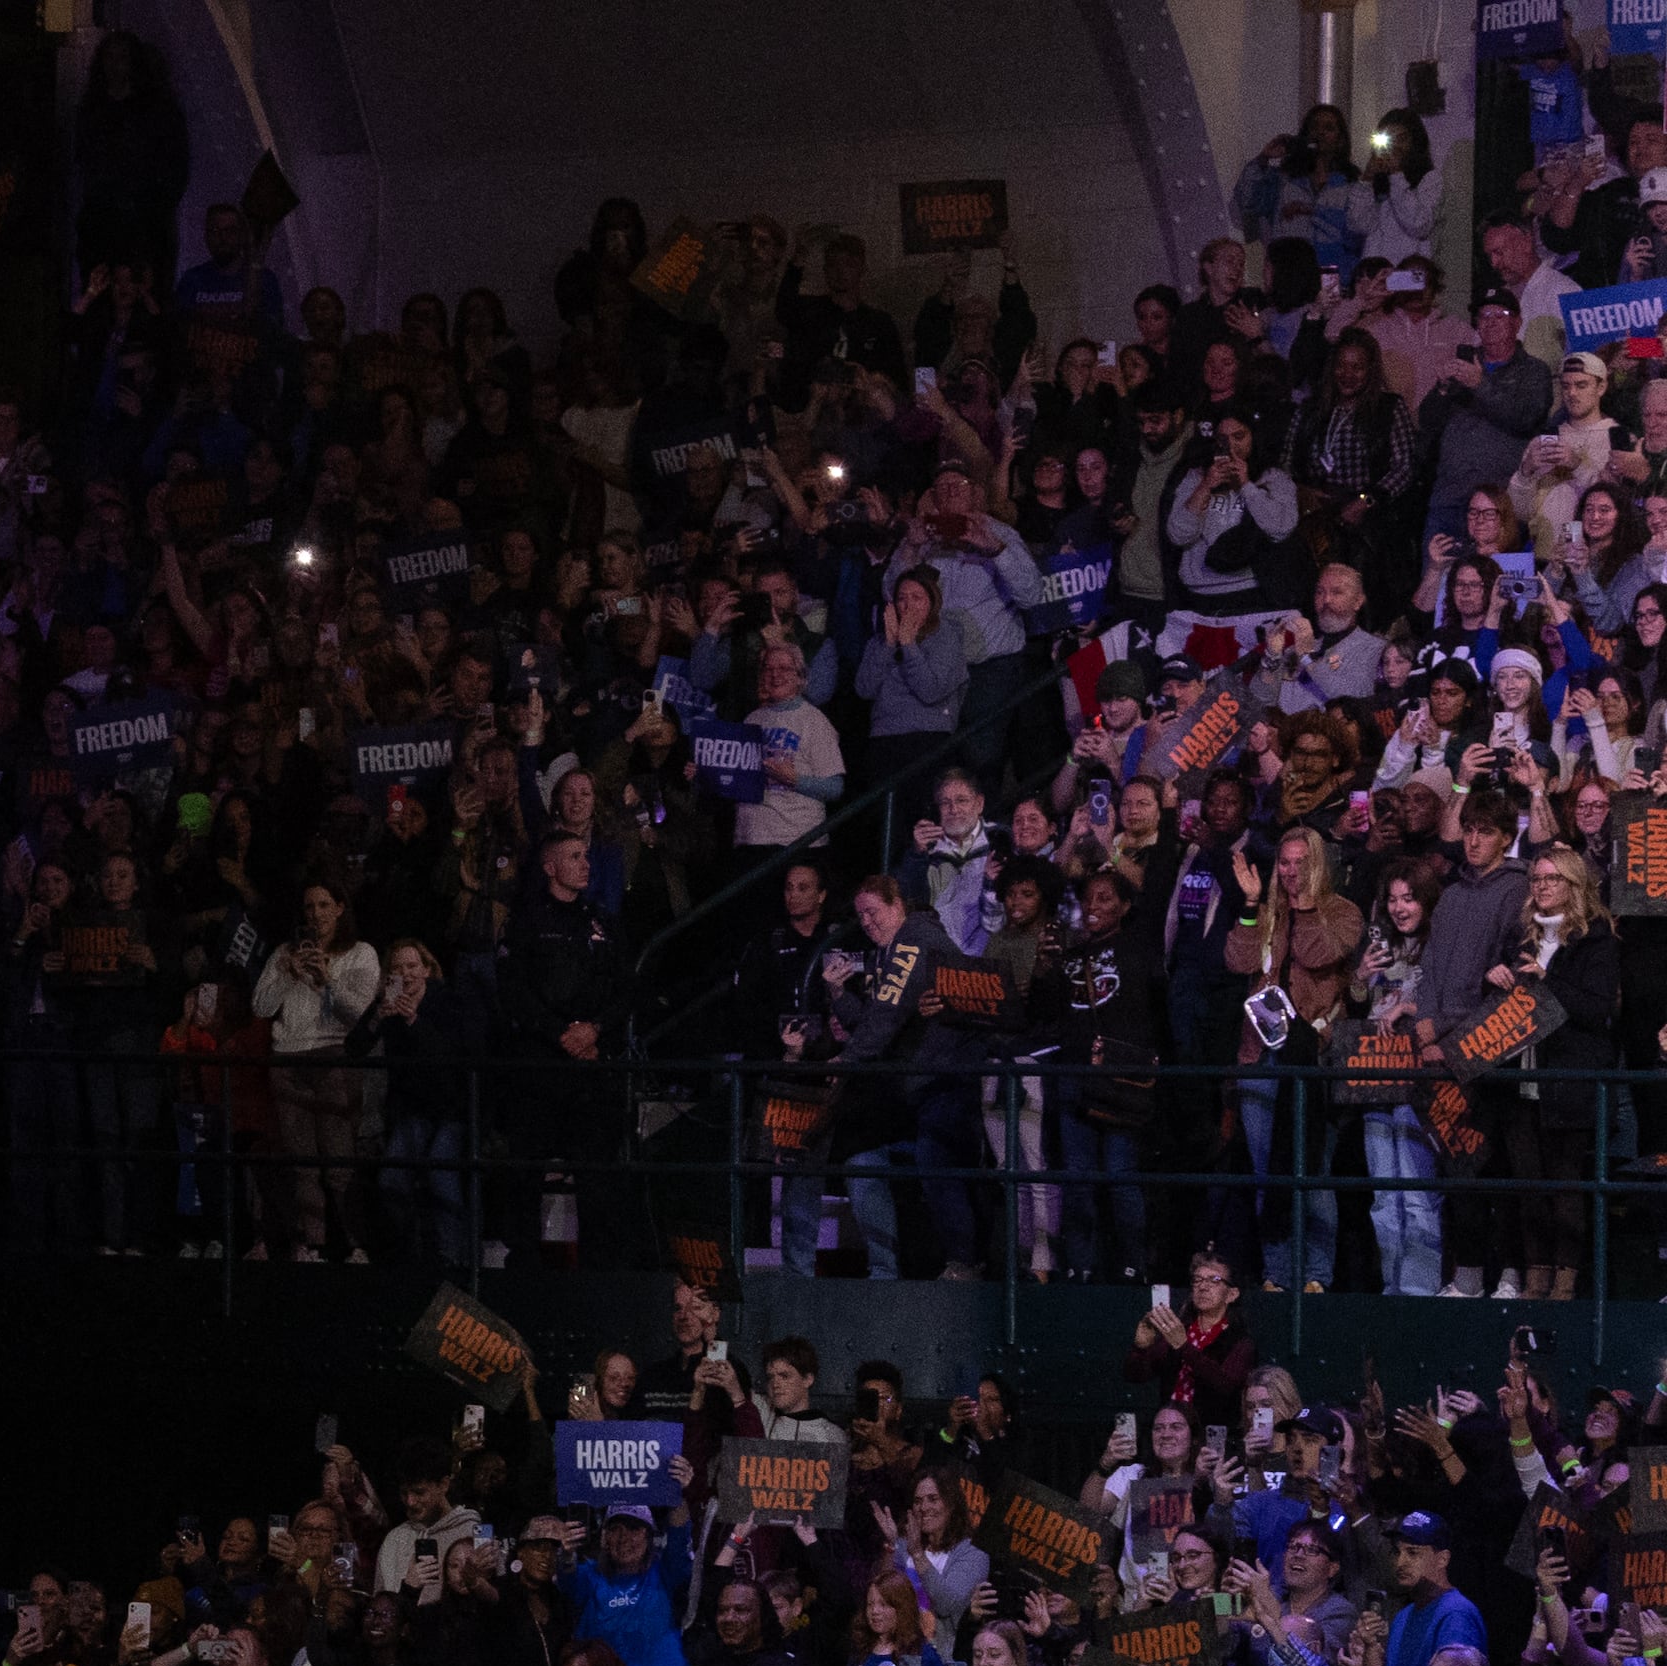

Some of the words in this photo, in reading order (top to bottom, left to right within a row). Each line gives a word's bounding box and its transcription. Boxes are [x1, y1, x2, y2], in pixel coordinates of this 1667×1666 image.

[1482, 0, 1557, 32] FREEDOM
[1573, 297, 1663, 337] FREEDOM
[387, 543, 468, 583] FREEDOM
[76, 713, 168, 754] FREEDOM
[1169, 692, 1240, 771] HARRIS
[357, 740, 453, 773] FREEDOM
[694, 737, 762, 771] FREEDOM
[877, 944, 919, 1005] 1775
[936, 967, 1005, 1000] HARRIS
[1459, 985, 1537, 1060] HARRIS
[439, 1304, 523, 1373] HARRIS
[576, 1439, 660, 1470] HARRIS
[738, 1456, 831, 1492] HARRIS
[588, 1470, 649, 1488] WALZ
[751, 1489, 814, 1511] WALZ
[1005, 1495, 1102, 1564] HARRIS
[1010, 1533, 1077, 1577] WALZ
[1113, 1621, 1202, 1664] HARRIS
